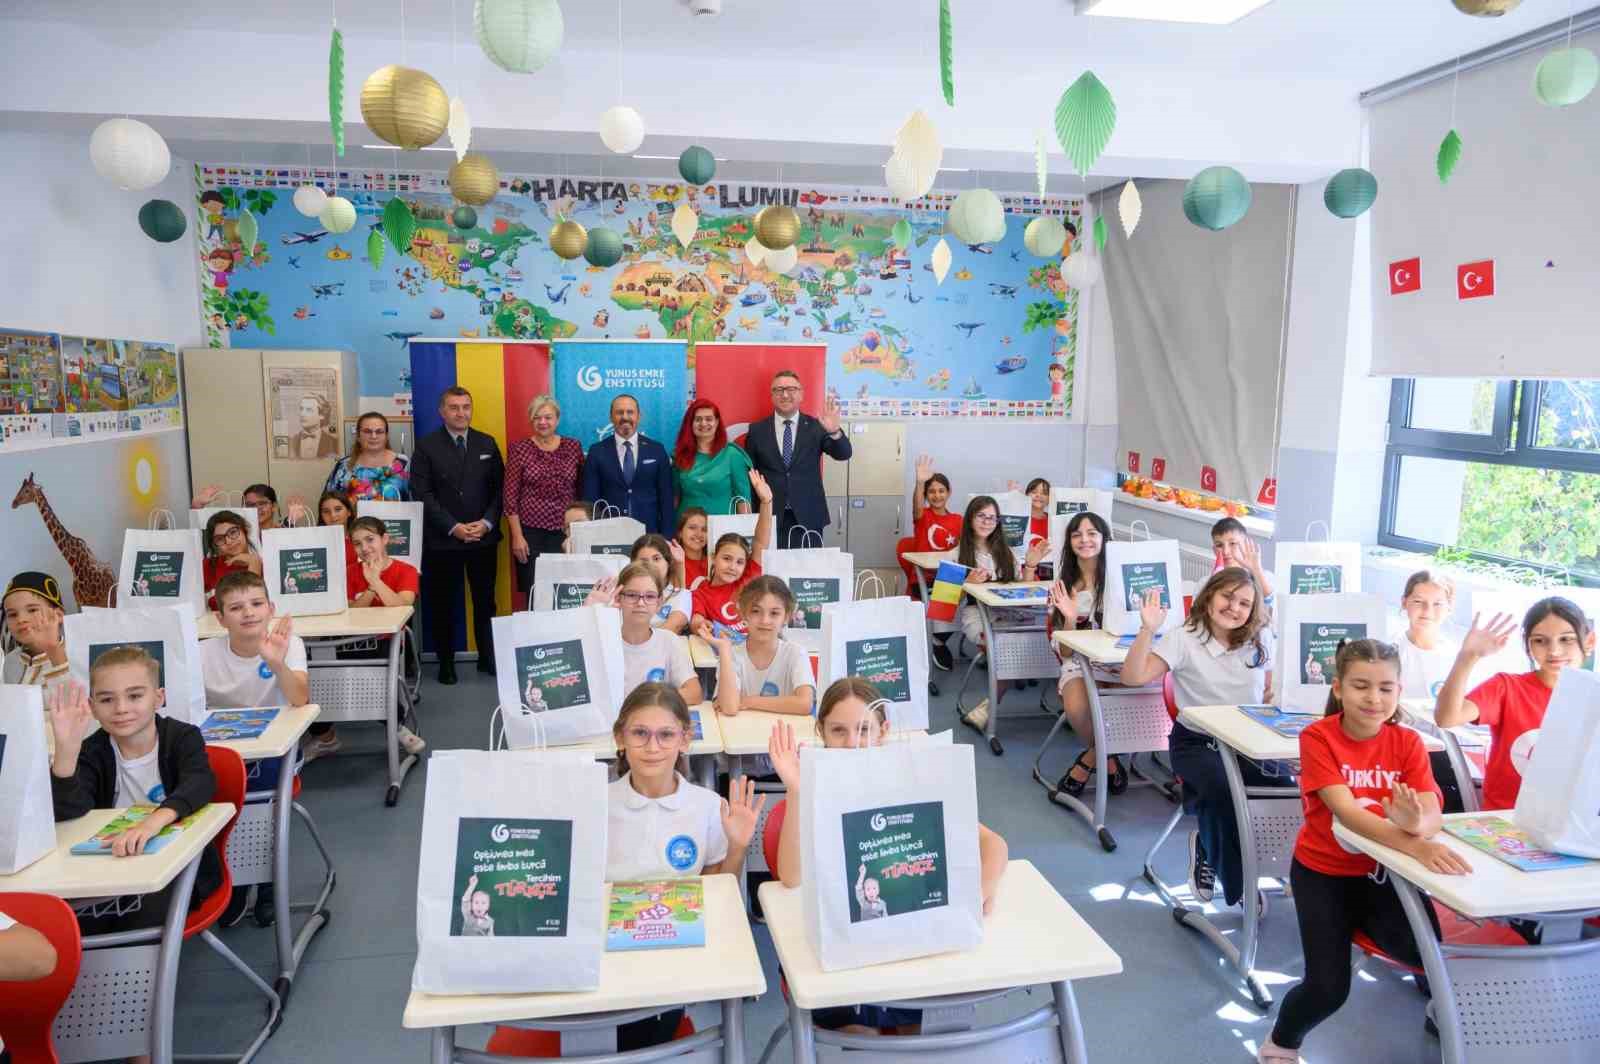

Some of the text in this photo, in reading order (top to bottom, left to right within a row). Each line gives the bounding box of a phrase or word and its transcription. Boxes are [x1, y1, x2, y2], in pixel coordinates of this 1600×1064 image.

[532, 179, 799, 209] HARTA LUMII
[605, 368, 665, 378] YUNUS EMRE
[1341, 764, 1401, 789] ÜRKİY
